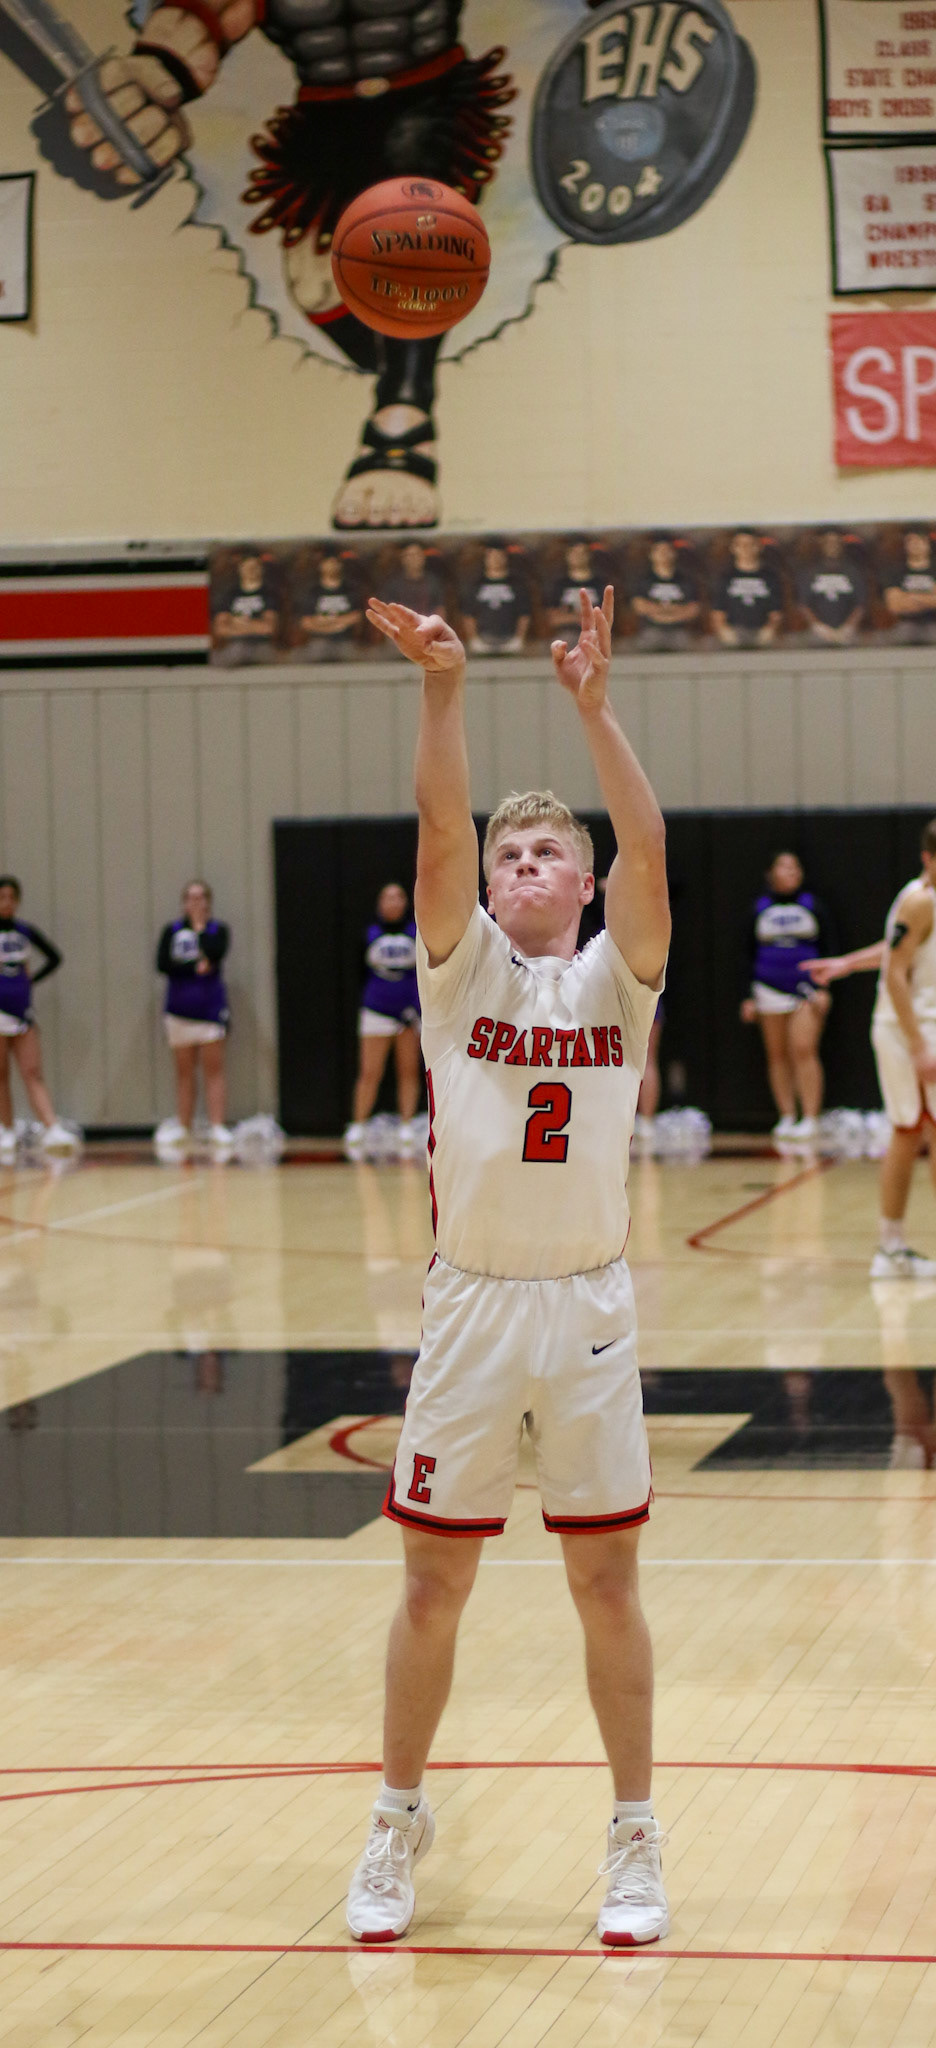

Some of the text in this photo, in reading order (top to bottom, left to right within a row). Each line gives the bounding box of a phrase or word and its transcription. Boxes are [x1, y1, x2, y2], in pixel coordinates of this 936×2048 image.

[583, 3, 716, 101] EHS
[845, 67, 892, 88] STATE
[828, 97, 932, 117] BOYS CROSS
[559, 160, 663, 216] 2004
[370, 229, 475, 264] SPALDING
[467, 1016, 623, 1067] SPARTANS
[522, 1082, 572, 1163] 2
[407, 1453, 437, 1504] E
